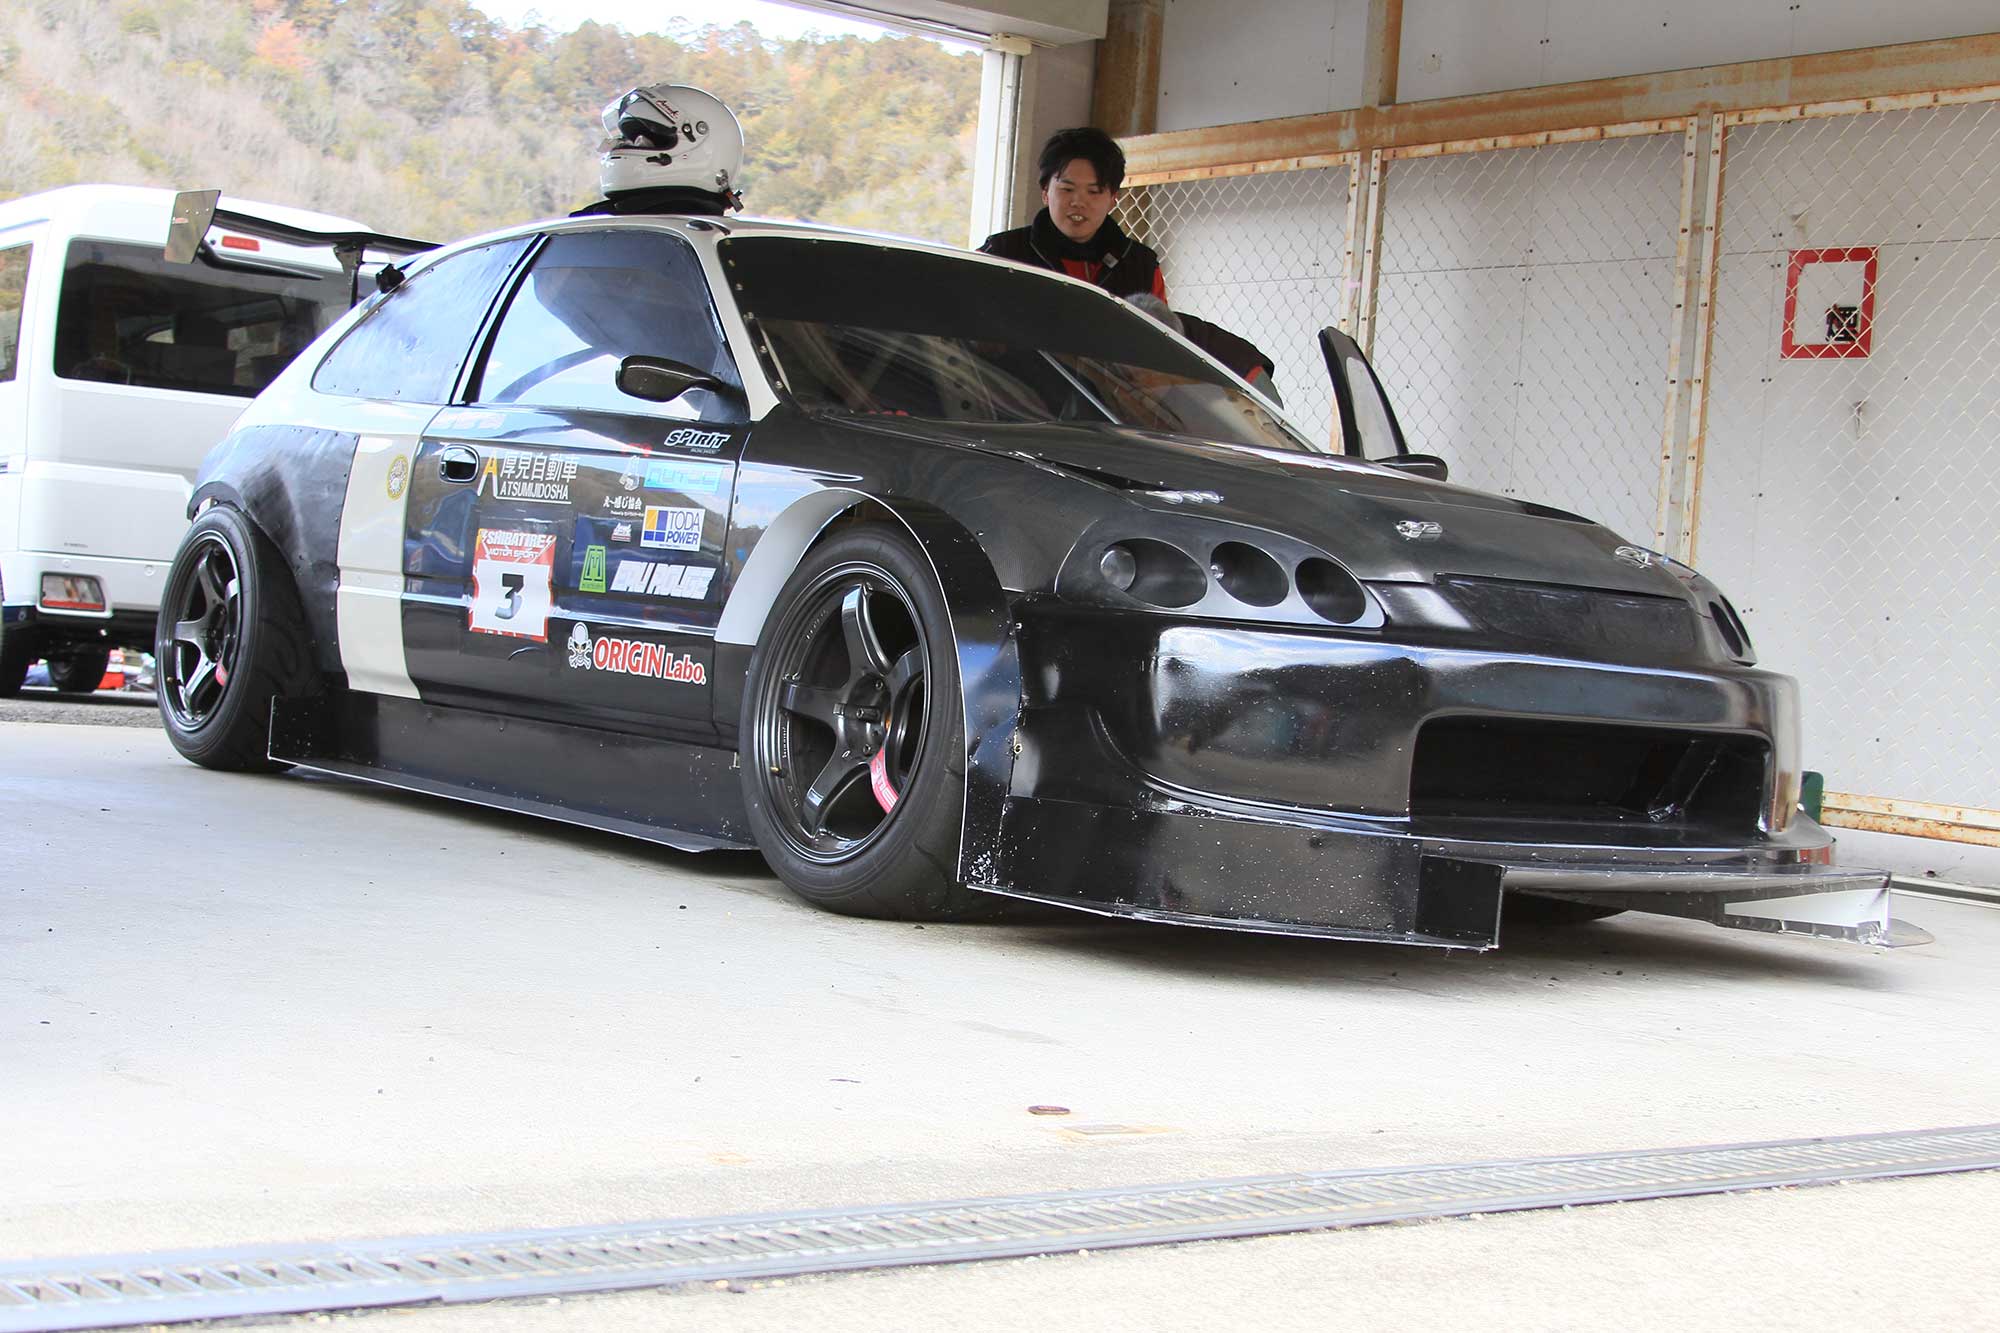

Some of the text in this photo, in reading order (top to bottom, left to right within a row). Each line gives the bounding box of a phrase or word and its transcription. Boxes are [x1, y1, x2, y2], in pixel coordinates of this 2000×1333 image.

[664, 428, 731, 448] SPIRIT
[669, 510, 700, 531] TODA
[666, 531, 699, 545] POWER
[495, 573, 524, 620] 3
[593, 637, 665, 678] ORIGIN
